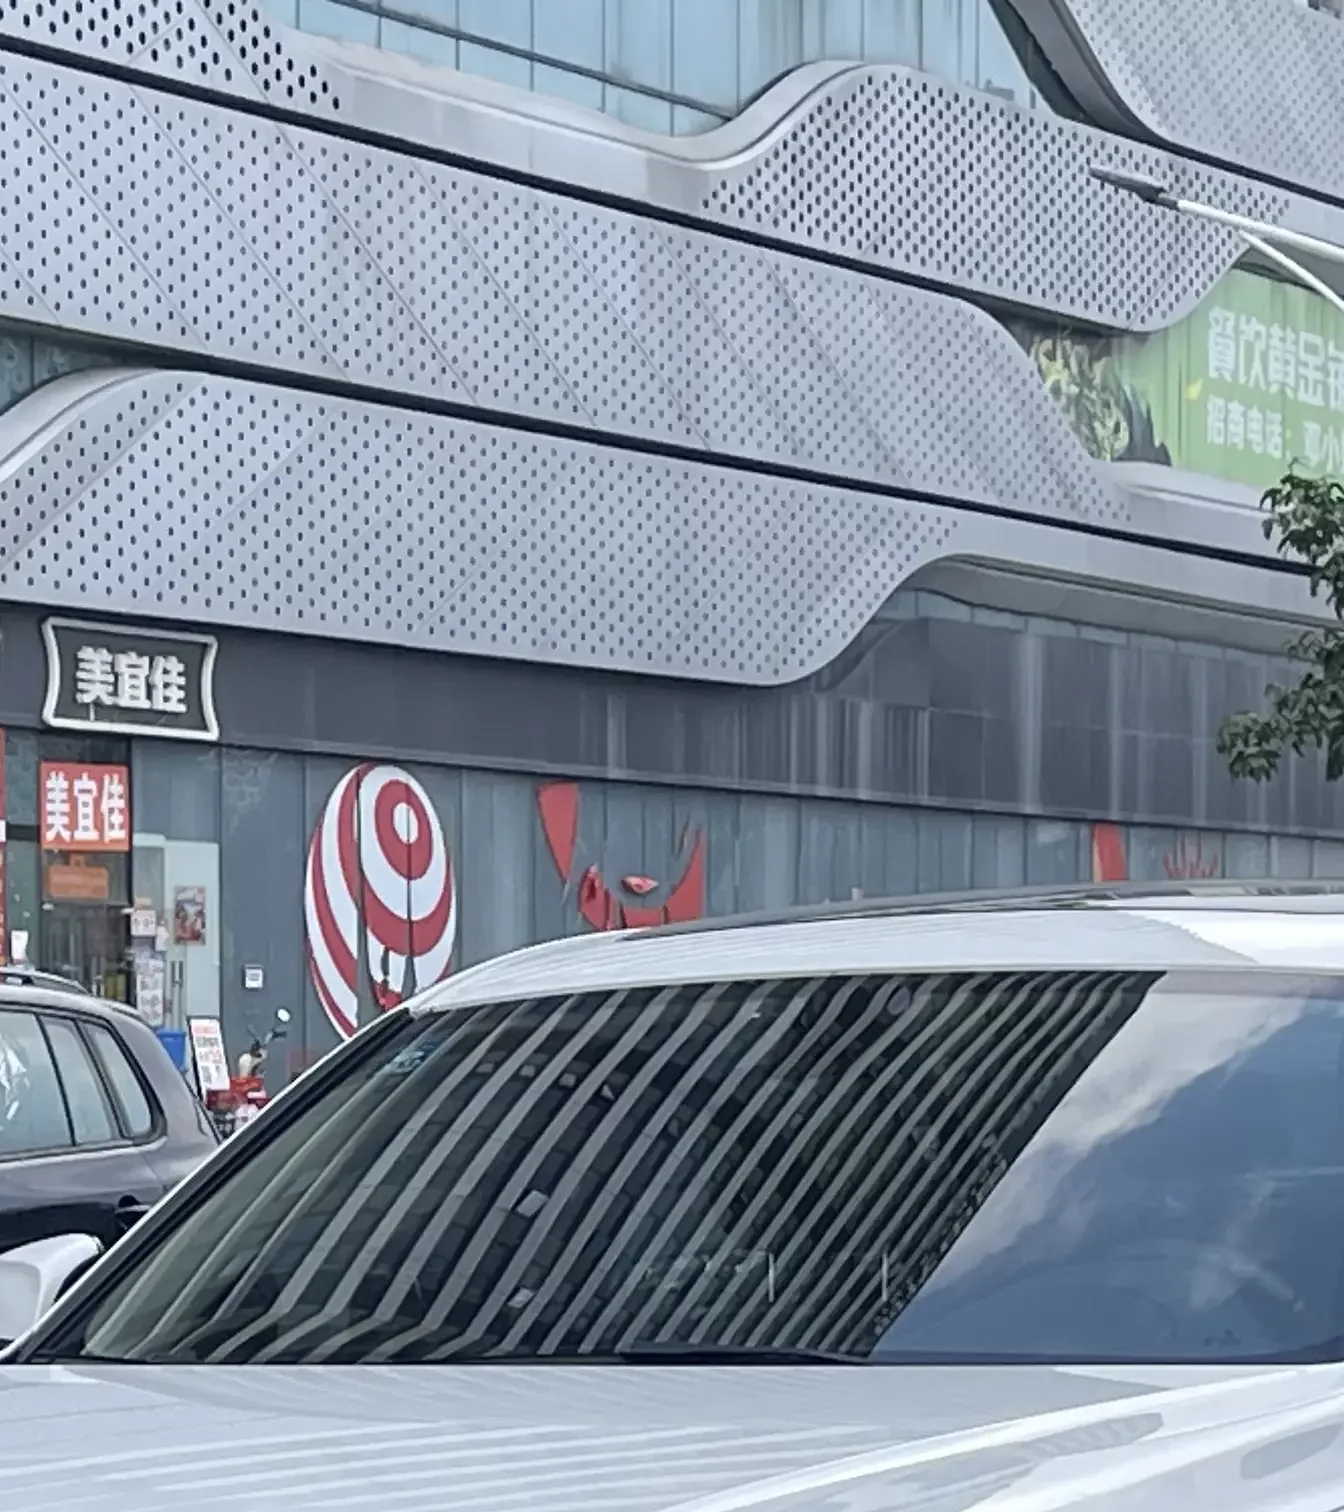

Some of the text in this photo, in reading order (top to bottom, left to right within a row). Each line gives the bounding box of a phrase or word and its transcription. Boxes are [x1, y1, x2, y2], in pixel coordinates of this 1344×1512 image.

[76, 645, 187, 714] 美宜佳
[45, 770, 128, 843] 美宜佳
